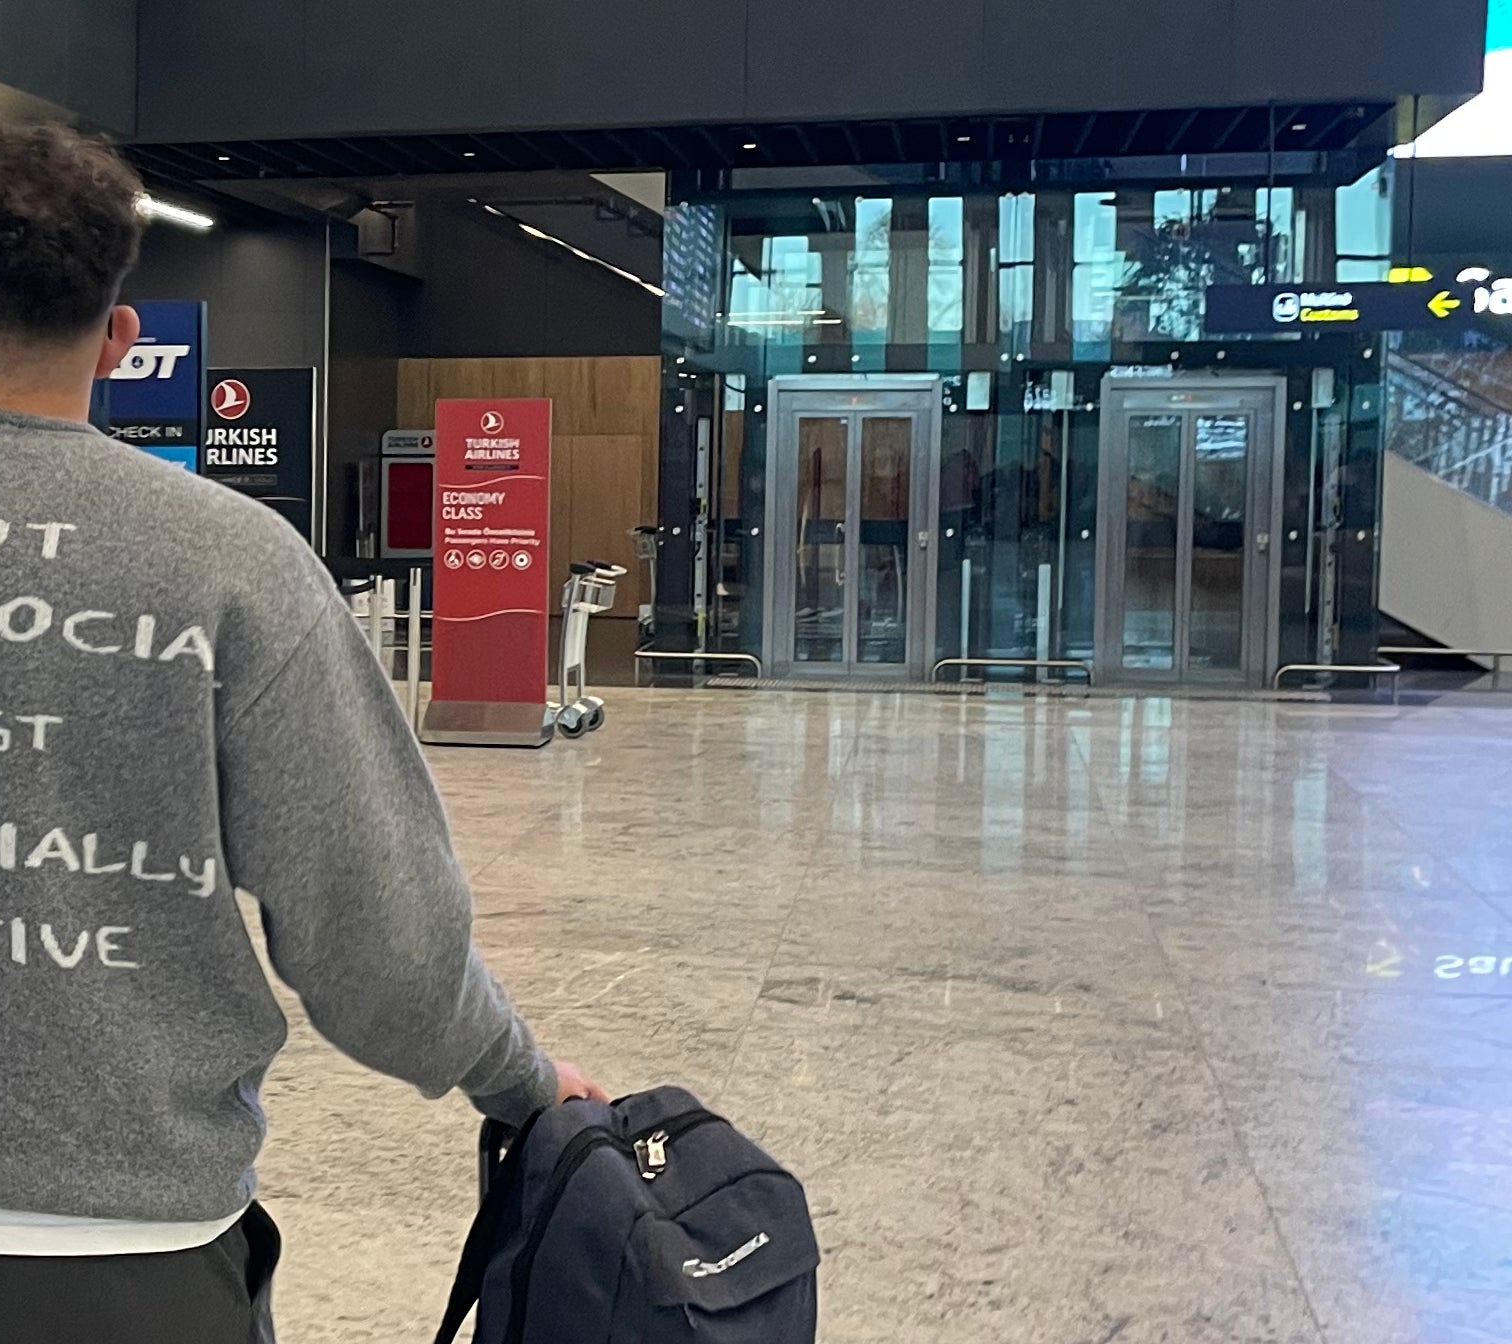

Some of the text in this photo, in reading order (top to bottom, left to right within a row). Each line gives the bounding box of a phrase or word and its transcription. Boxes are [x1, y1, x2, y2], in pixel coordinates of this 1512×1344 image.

[165, 426, 183, 437] IN
[465, 438, 520, 449] TURKISH
[206, 448, 278, 465] RLINES
[464, 449, 520, 460] AIRLINES
[443, 492, 506, 505] ECONOMY
[442, 507, 483, 520] CLASS
